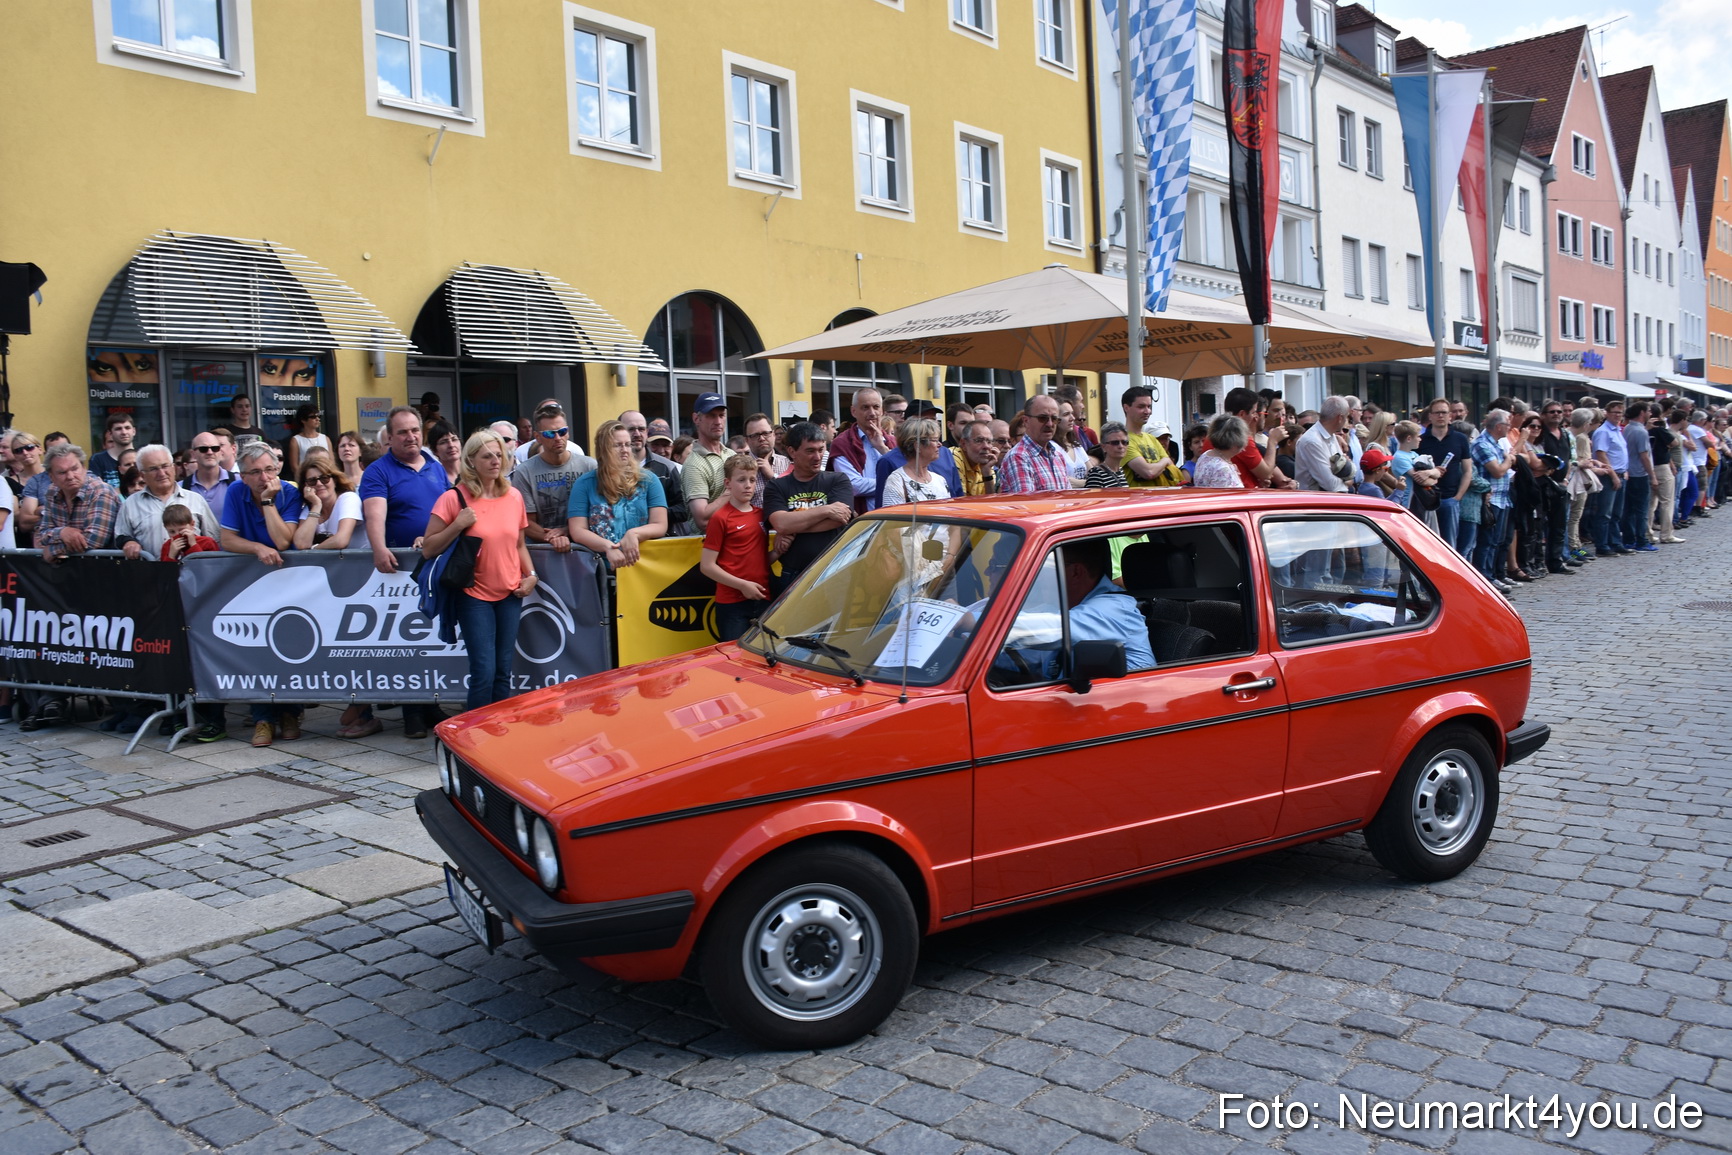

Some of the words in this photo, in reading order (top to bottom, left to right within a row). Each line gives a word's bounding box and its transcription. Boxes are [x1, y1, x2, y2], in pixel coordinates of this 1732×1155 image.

[90, 388, 123, 400] Digitale
[124, 389, 150, 399] Bilder
[273, 393, 312, 402] Passbilder
[1089, 389, 1097, 399] 24
[535, 472, 563, 483] UNCLE
[917, 611, 943, 627] 646
[133, 638, 171, 654] GmbH
[41, 647, 85, 665] Freystadt
[90, 652, 134, 669] Pyrbaum
[328, 648, 417, 658] BREITENBRUNN
